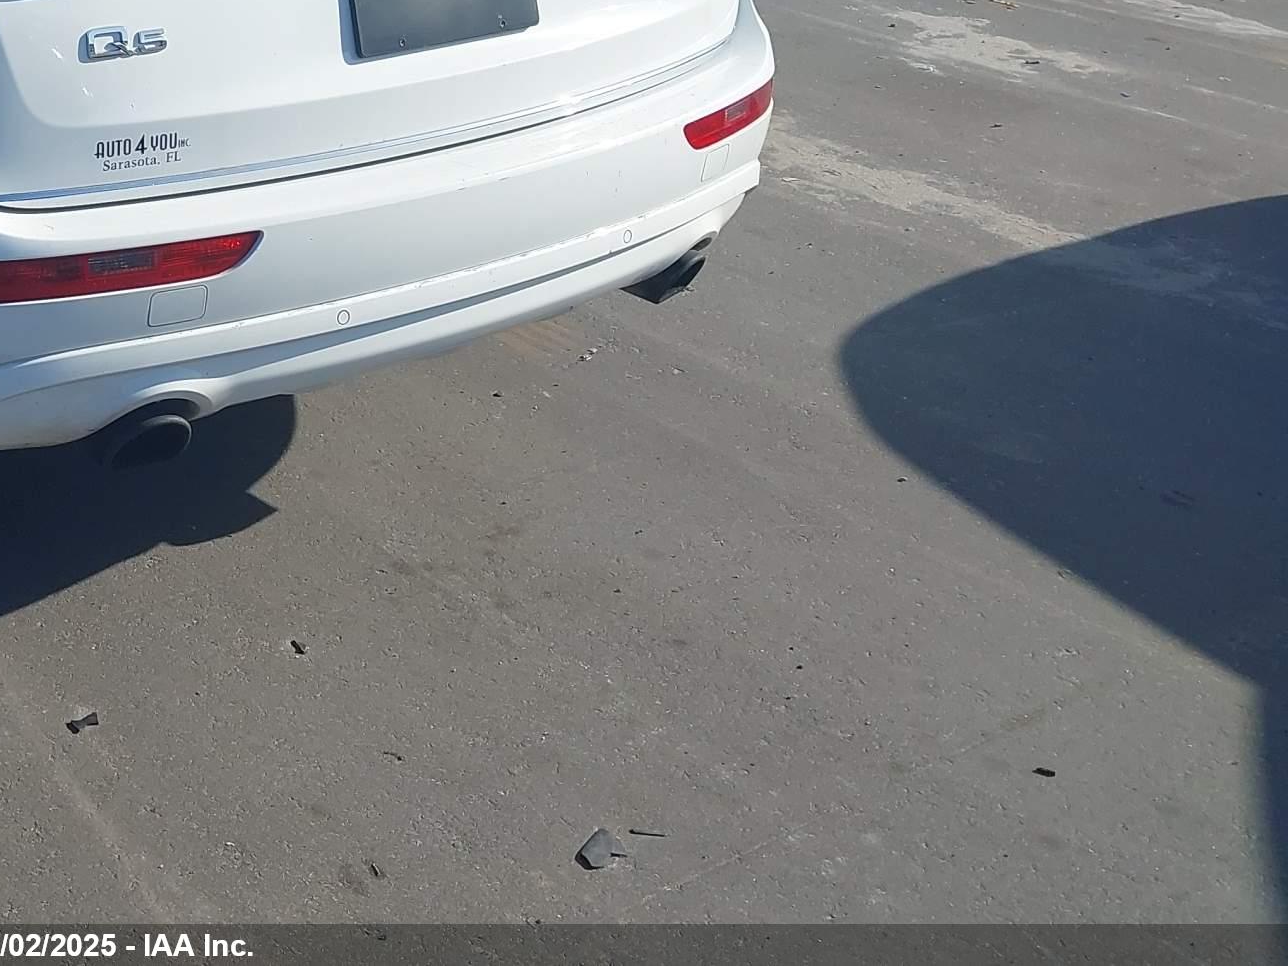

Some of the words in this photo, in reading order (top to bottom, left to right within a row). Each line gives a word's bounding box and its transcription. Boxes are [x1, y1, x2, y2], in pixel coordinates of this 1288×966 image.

[77, 26, 168, 64] Q5
[94, 138, 132, 159] AUTO
[134, 133, 147, 155] 4
[150, 132, 178, 151] YOU
[102, 156, 160, 172] Sarasota,
[166, 150, 181, 163] FL
